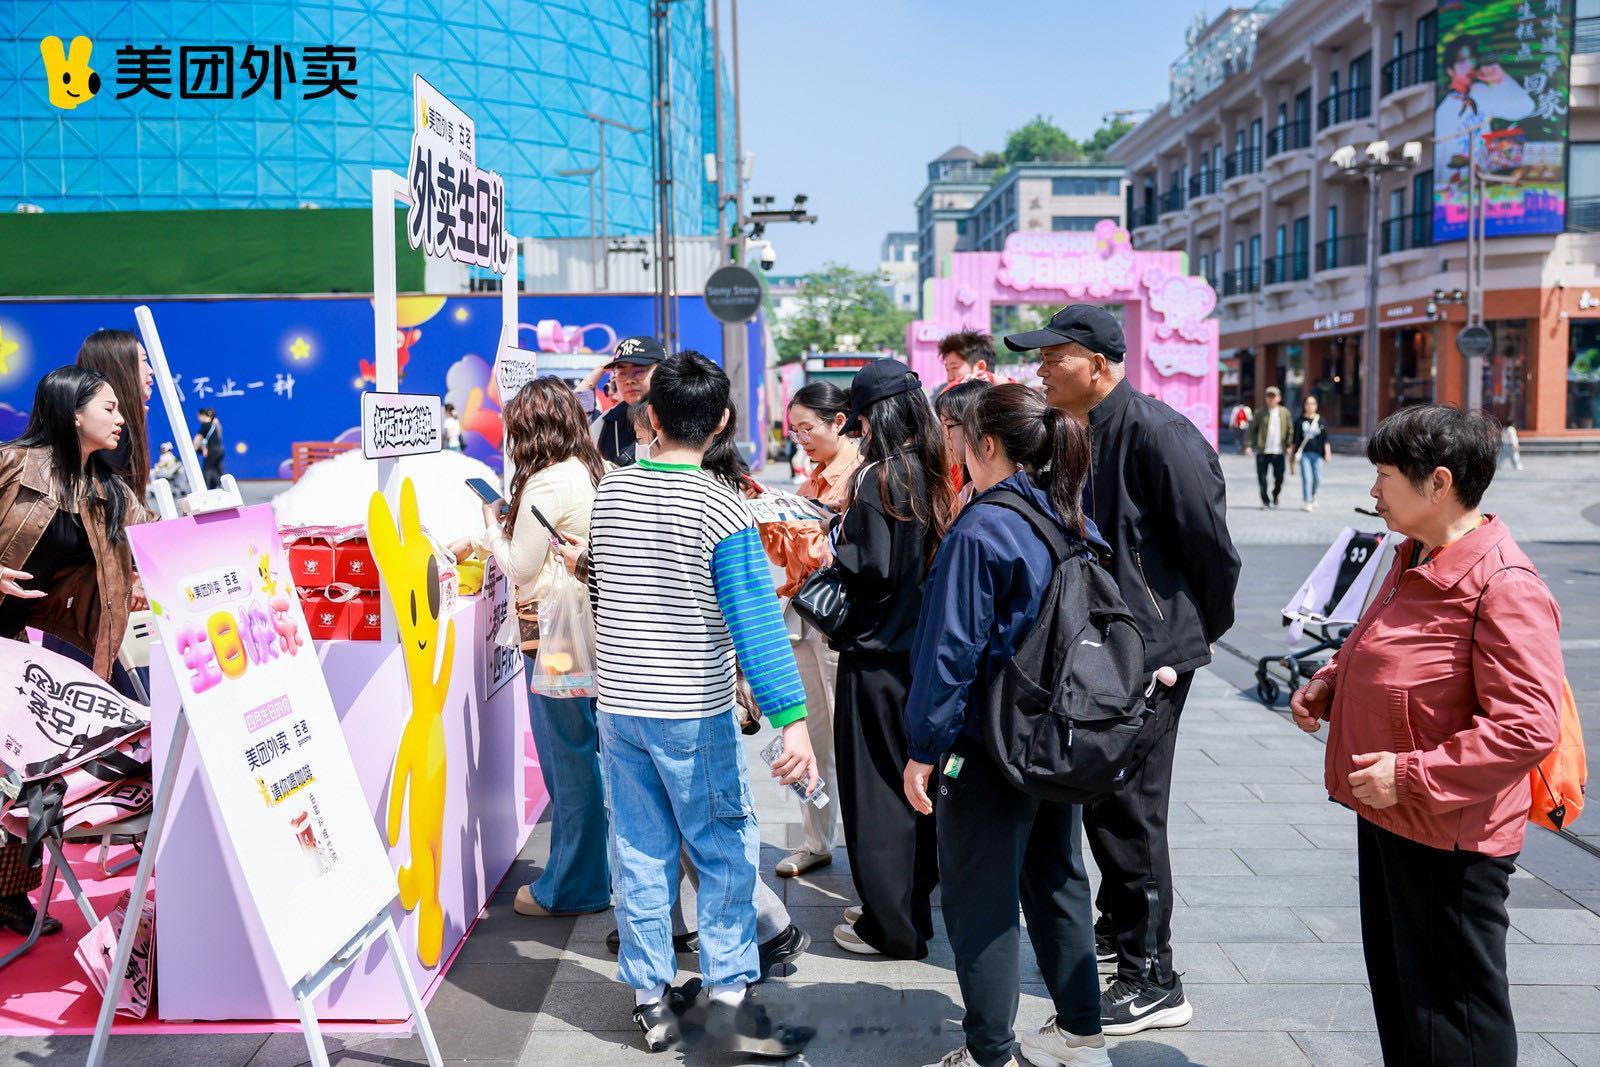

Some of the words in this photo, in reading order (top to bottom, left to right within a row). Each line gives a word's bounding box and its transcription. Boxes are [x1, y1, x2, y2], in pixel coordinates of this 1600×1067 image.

[428, 107, 454, 146] 美团外卖
[458, 121, 472, 150] 古茗
[413, 145, 508, 265] 外卖生日礼
[193, 580, 222, 599] 美团外卖
[223, 571, 239, 586] 古茗
[176, 598, 304, 694] 生日快乐
[27, 689, 76, 736] 古茗
[245, 731, 291, 772] 美团外卖
[293, 719, 309, 738] 古茗
[270, 764, 313, 801] 请你喝咖啡
